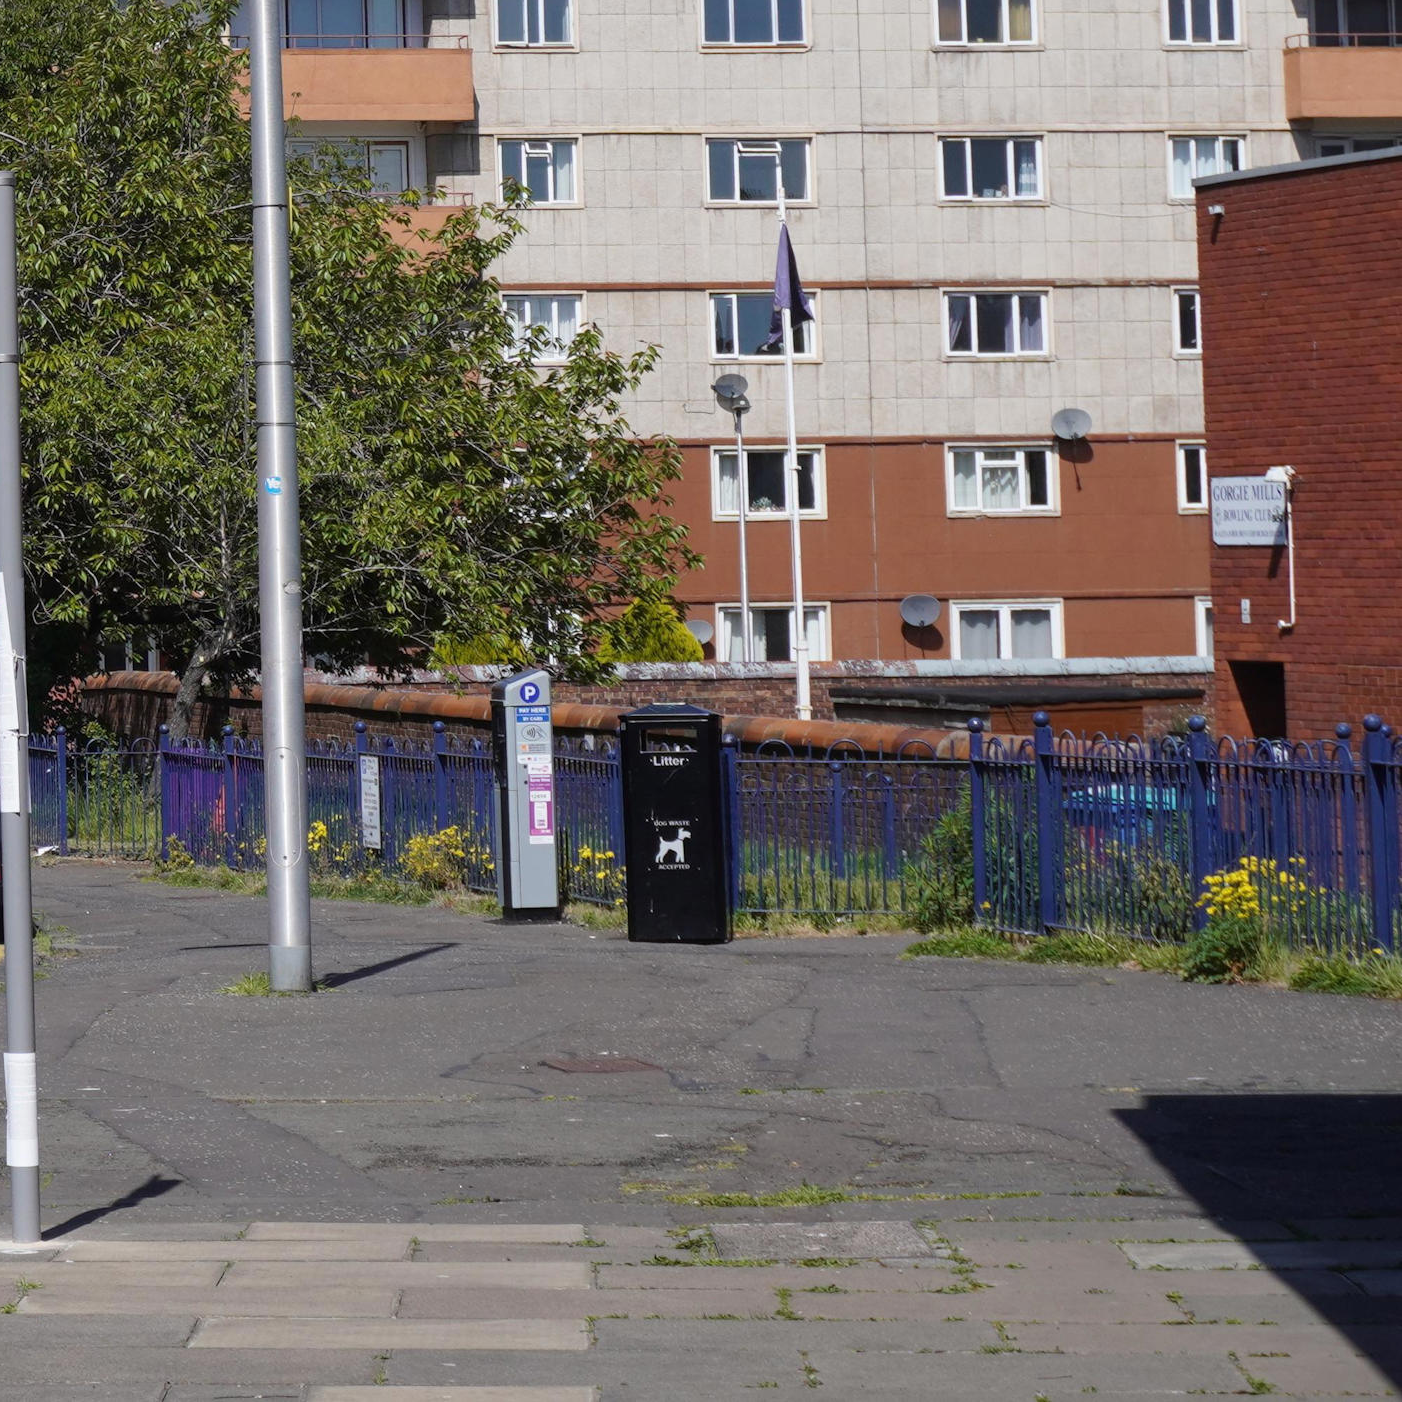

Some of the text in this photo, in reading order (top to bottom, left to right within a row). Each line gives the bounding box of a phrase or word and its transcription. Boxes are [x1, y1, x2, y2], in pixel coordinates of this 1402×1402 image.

[1213, 484, 1282, 502] GORGIE MILLS
[524, 685, 536, 700] P
[653, 756, 685, 767] Litter
